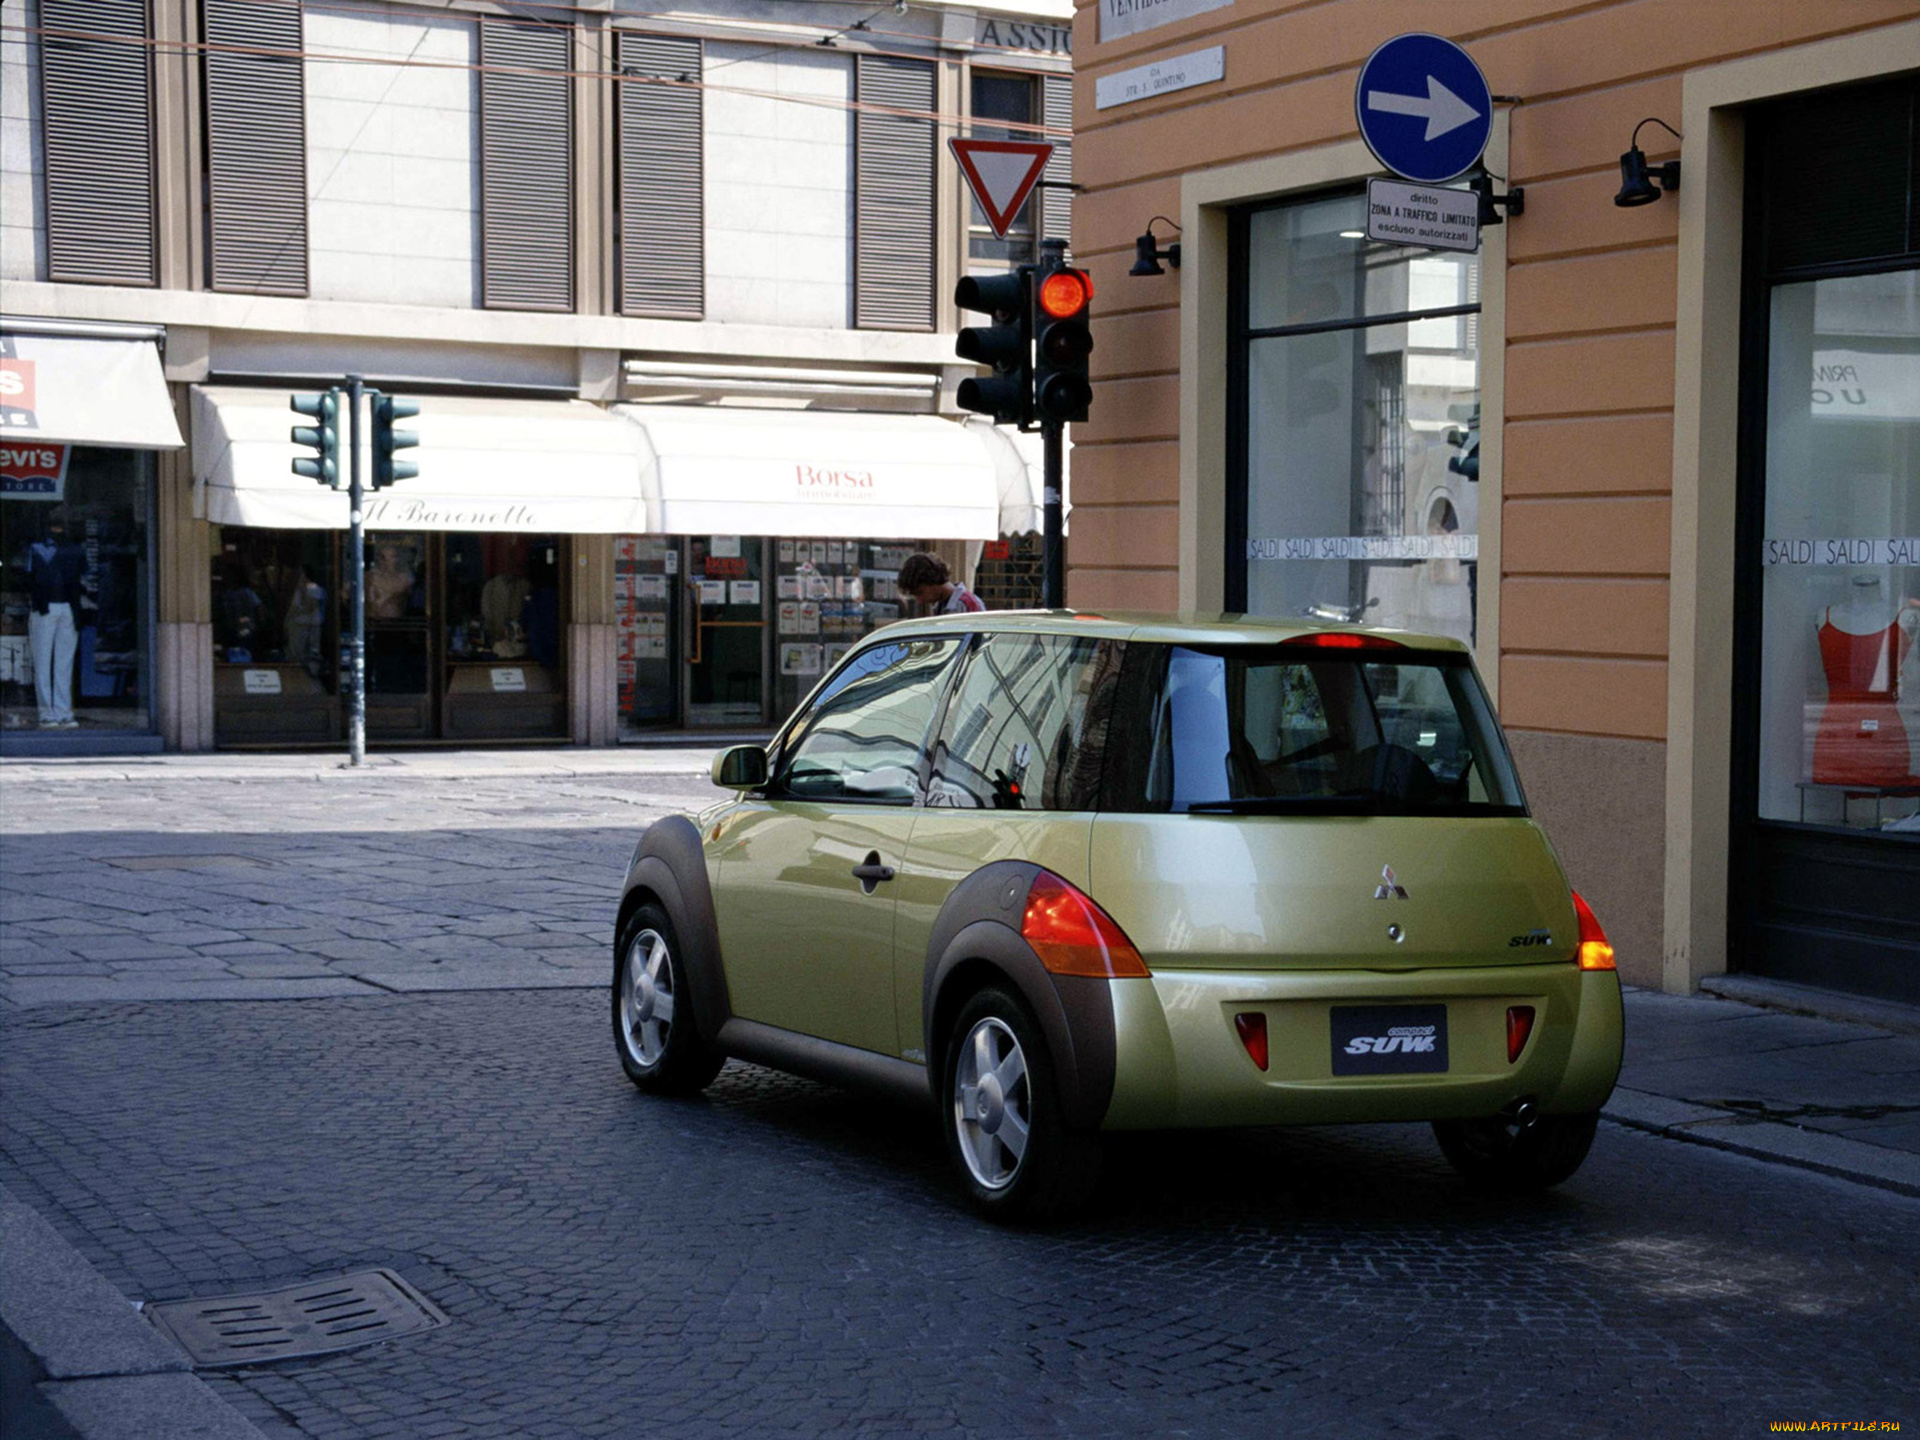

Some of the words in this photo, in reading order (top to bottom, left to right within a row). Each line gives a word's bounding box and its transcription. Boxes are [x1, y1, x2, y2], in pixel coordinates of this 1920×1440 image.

[1410, 193, 1439, 205] diritto
[1371, 204, 1391, 216] ZONA
[1394, 207, 1400, 217] A
[1403, 208, 1438, 222] TRAFFICO
[1442, 213, 1476, 227] LIMITATO
[1378, 223, 1415, 235] escluso
[1419, 229, 1468, 241] autorizzati
[796, 464, 873, 487] Borsa
[1251, 539, 1279, 559] SALDI
[1286, 539, 1314, 558] SALDI
[1321, 538, 1351, 558] SALDI
[1401, 537, 1433, 557] SALDI
[1769, 540, 1816, 564] SALDI
[1826, 540, 1875, 564] SALDI
[1388, 1025, 1435, 1036] compact
